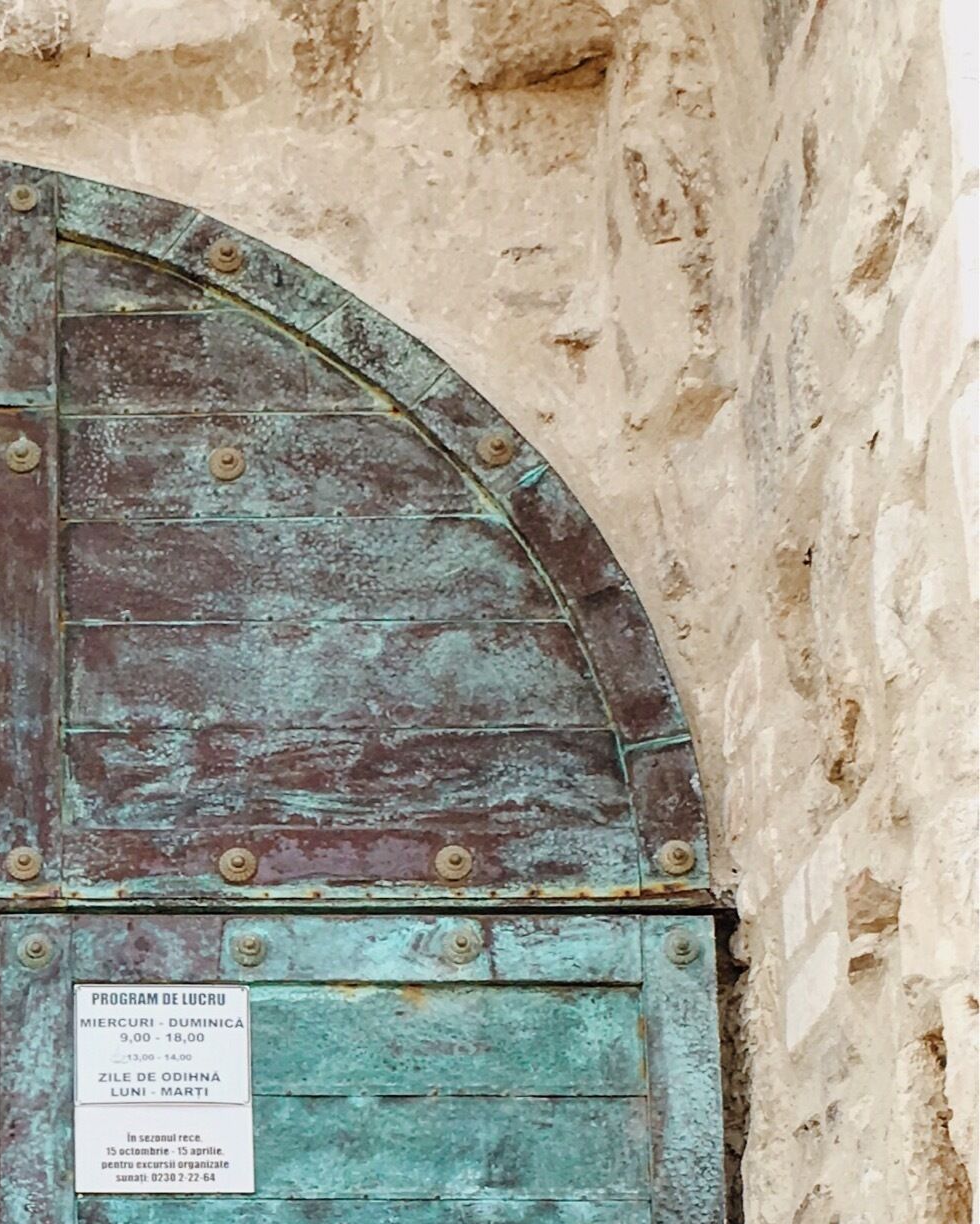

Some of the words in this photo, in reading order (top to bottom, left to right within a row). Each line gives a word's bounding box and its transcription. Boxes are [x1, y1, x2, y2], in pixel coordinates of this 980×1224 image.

[92, 993, 158, 1005] PROGRAM
[163, 993, 178, 1005] DE
[183, 993, 226, 1005] LUCRU
[80, 1018, 154, 1027] MIERCURI
[120, 1033, 151, 1043] 9,00
[166, 1033, 205, 1043] 18,00
[127, 1054, 155, 1062] 13,00
[98, 1072, 131, 1082] ZILE
[137, 1072, 156, 1082] DE
[111, 1087, 146, 1097] LUNI
[139, 1134, 176, 1142] sezonul
[107, 1147, 116, 1155] 15
[119, 1147, 169, 1155] octombrie
[178, 1147, 188, 1155] 15
[101, 1161, 133, 1169] pentru
[136, 1161, 175, 1169] excursii
[178, 1161, 229, 1170] organizate
[151, 1173, 176, 1182] 0230
